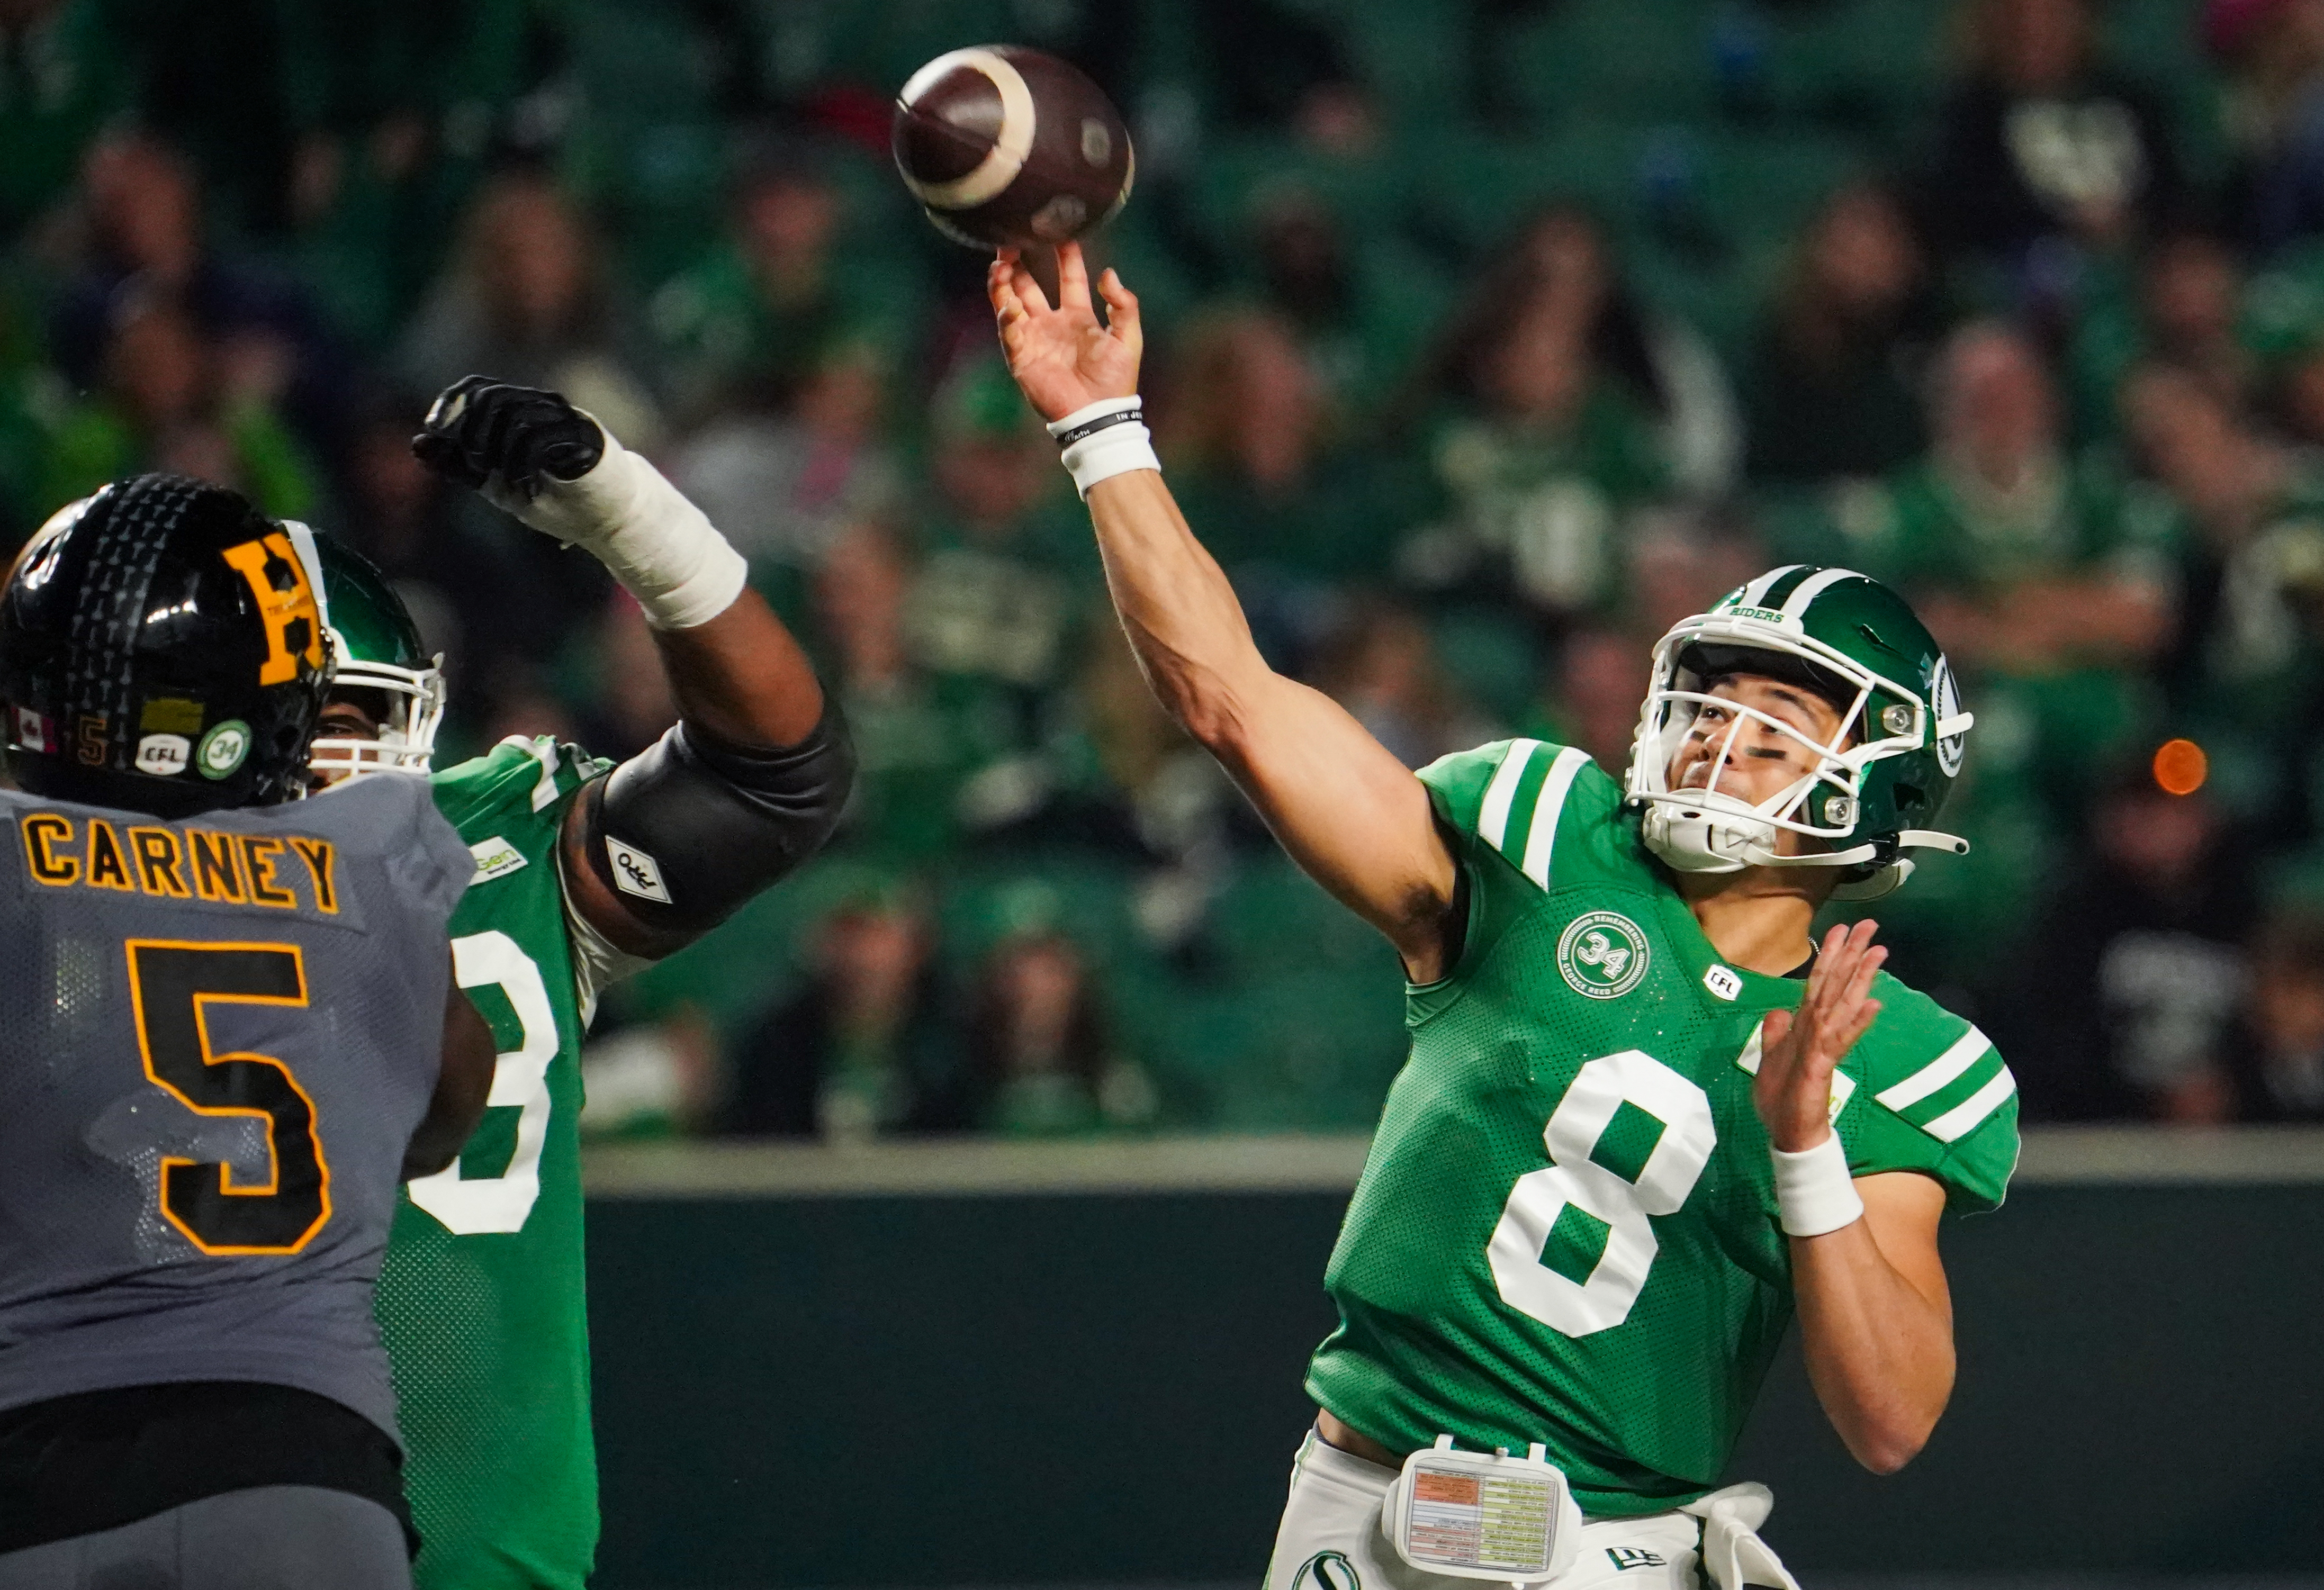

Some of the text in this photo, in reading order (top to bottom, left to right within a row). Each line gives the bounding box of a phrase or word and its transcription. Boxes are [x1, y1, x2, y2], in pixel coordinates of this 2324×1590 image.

[1729, 607, 1785, 623] RIDERS
[78, 716, 109, 766] 5
[145, 746, 185, 763] CFL
[211, 738, 239, 760] 34
[22, 813, 339, 915] CARNEY
[1594, 915, 1645, 950] REMEMBERING
[1577, 932, 1631, 980] 34
[1563, 963, 1611, 995] GEORGE REED
[1710, 972, 1732, 994] CFL
[125, 938, 332, 1256] 5
[1486, 1049, 1717, 1339] 8
